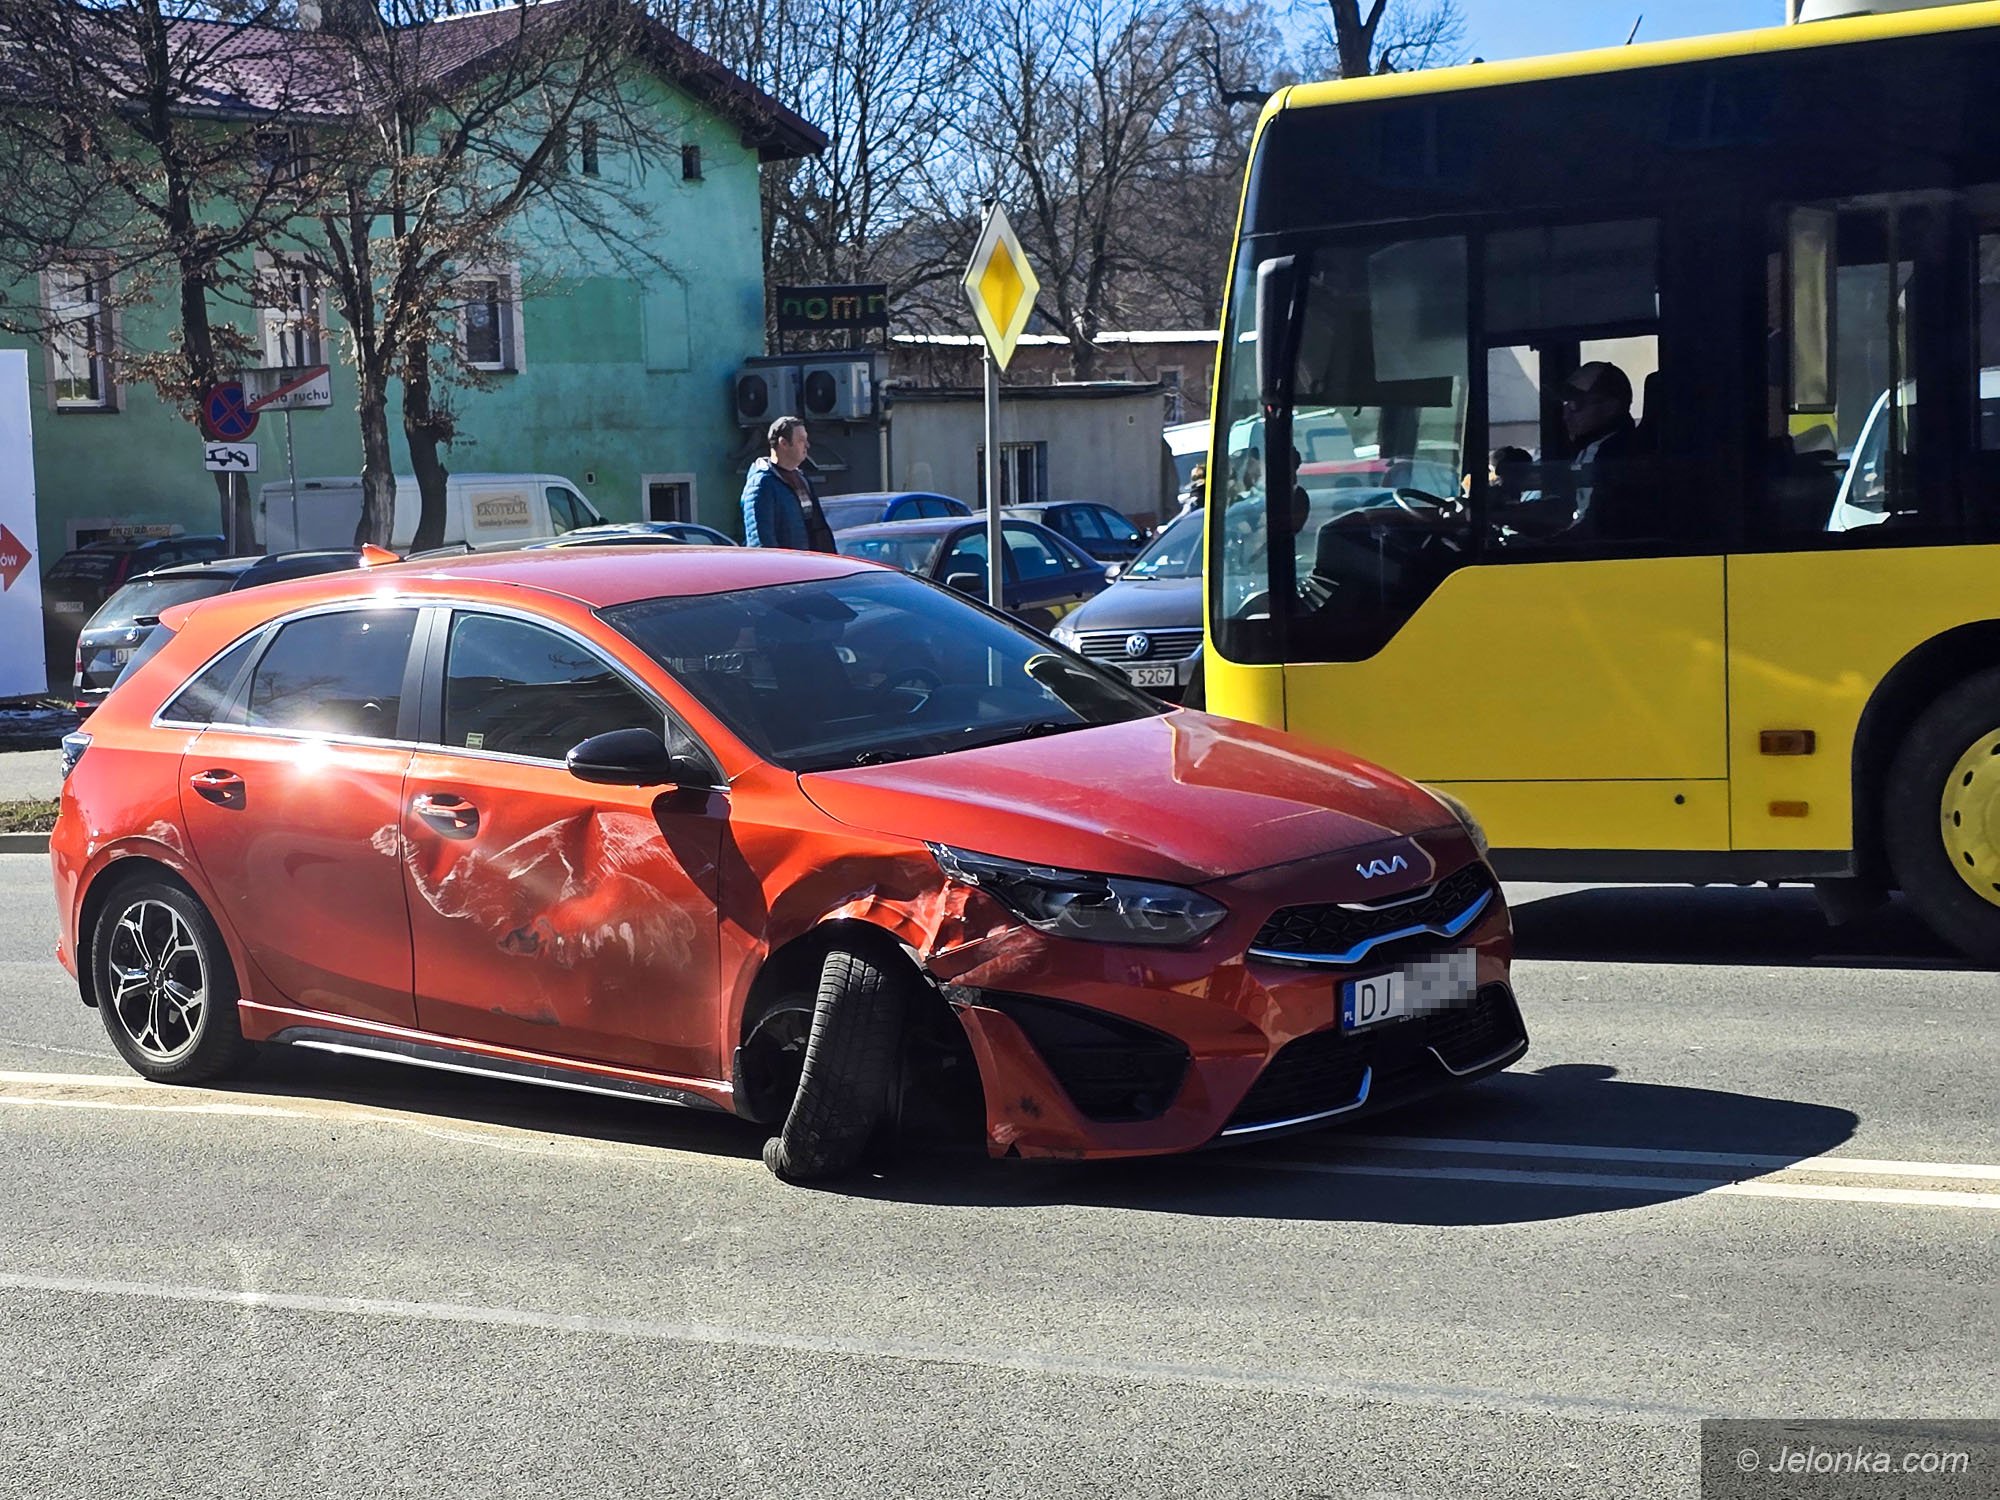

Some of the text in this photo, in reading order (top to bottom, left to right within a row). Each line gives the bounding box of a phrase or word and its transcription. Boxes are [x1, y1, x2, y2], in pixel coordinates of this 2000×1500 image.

[294, 389, 329, 403] ruchu
[1138, 669, 1173, 685] 52G7
[1356, 855, 1409, 880] KIA
[1344, 1010, 1354, 1022] PL
[1360, 977, 1392, 1022] DJ
